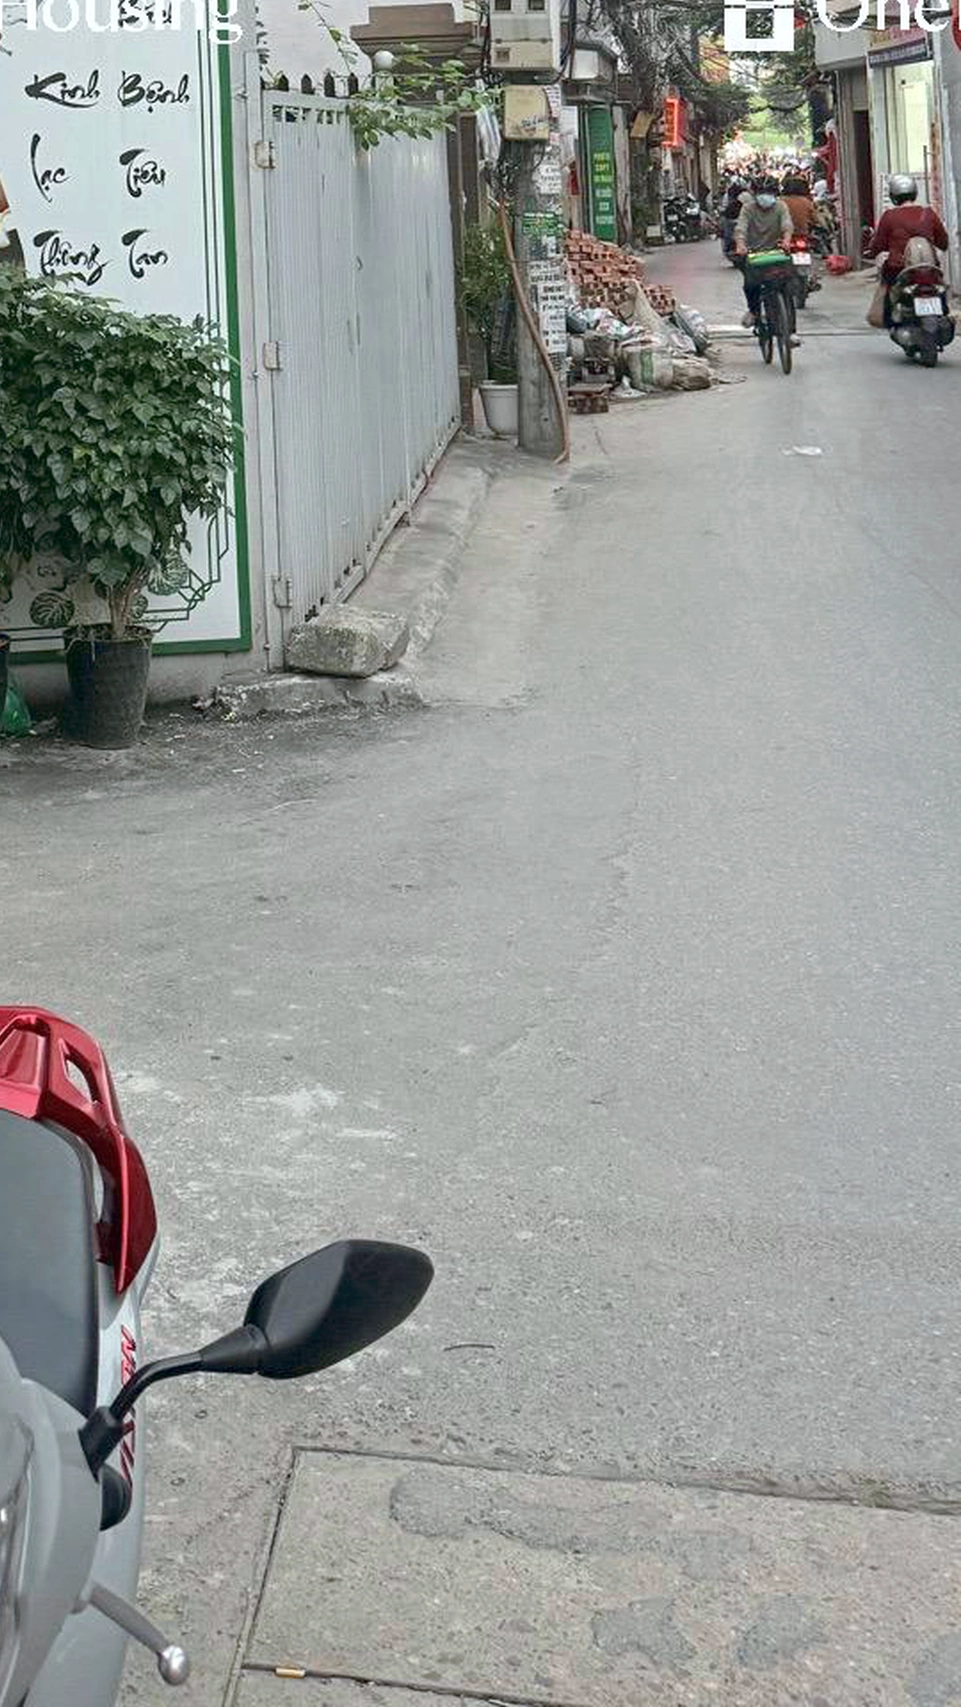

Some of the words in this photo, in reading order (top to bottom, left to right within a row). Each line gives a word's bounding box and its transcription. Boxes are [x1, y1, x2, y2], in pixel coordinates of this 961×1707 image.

[25, 69, 101, 109] Kinh
[117, 70, 191, 113] Bệnh
[30, 132, 74, 203] Lạc
[119, 148, 167, 198] Tiêu
[121, 229, 169, 279] Tan
